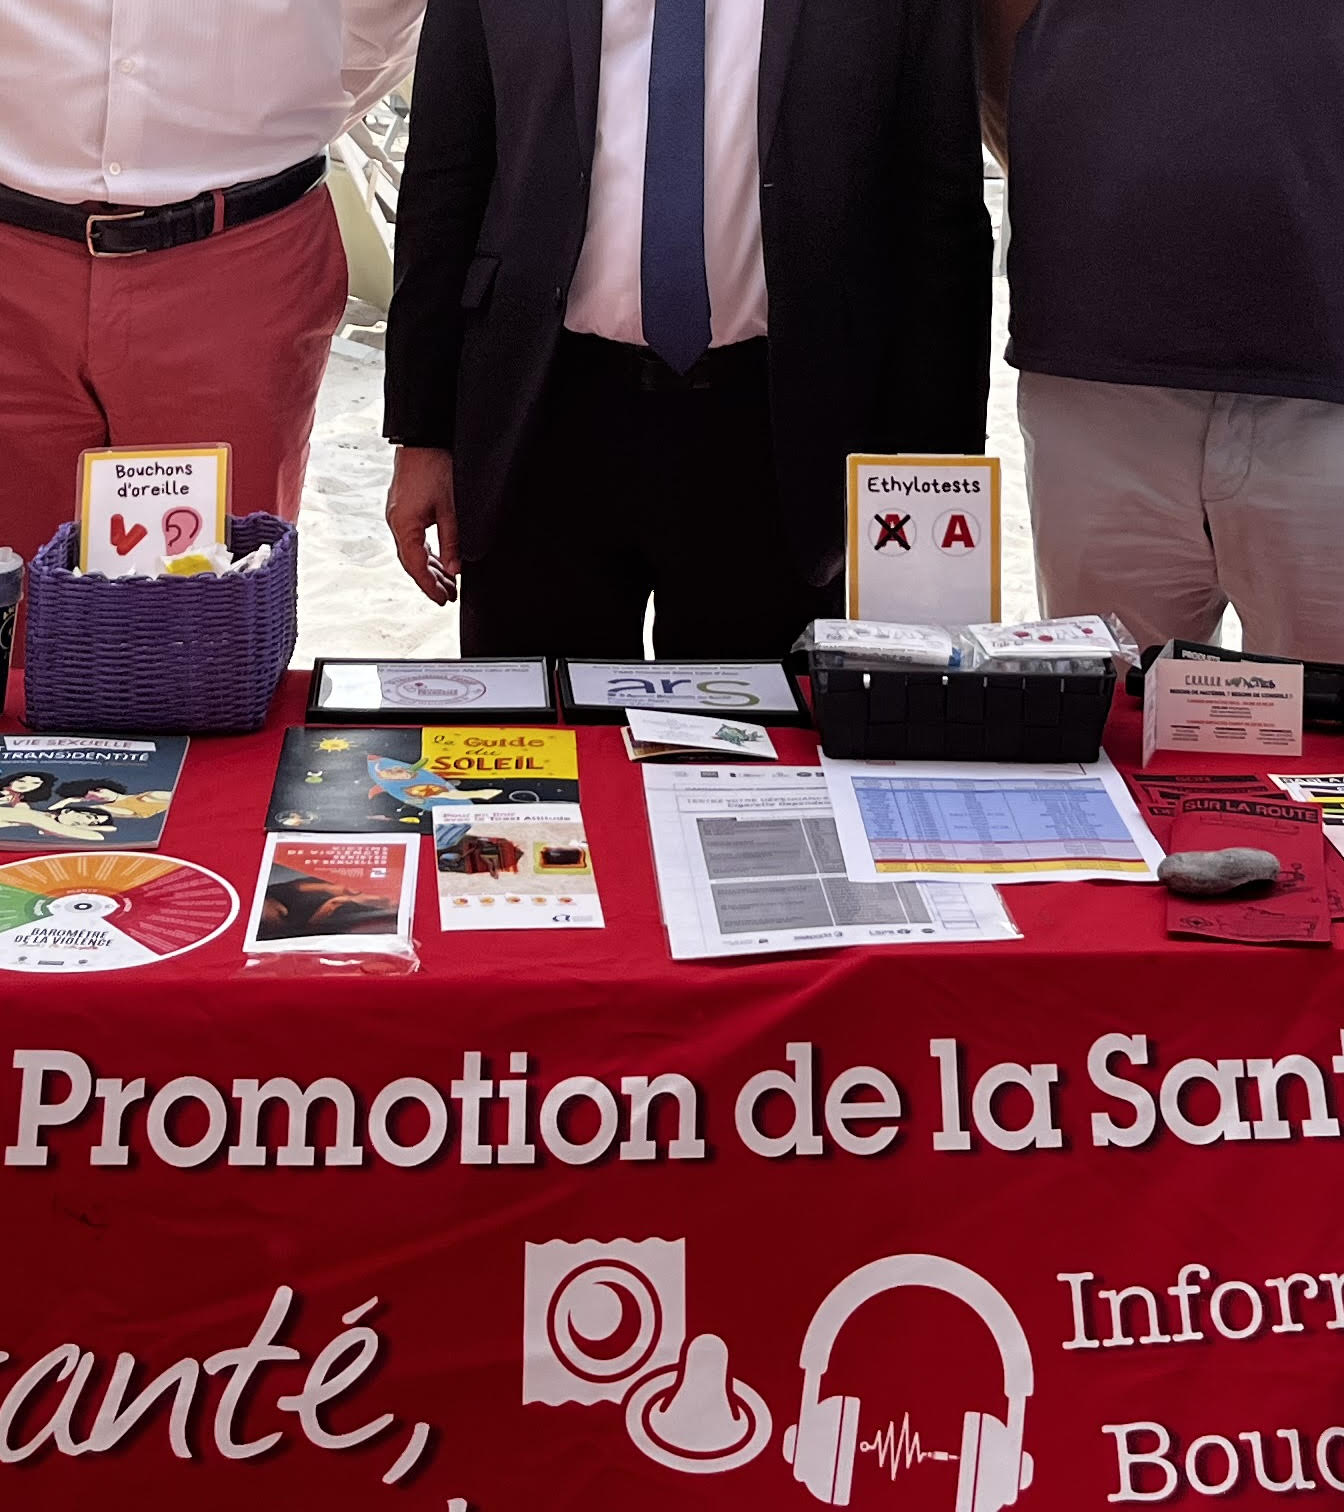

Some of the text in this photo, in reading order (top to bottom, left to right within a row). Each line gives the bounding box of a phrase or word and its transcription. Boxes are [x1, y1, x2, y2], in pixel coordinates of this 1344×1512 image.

[115, 462, 193, 479] Bouchons
[118, 480, 190, 498] d'oreille
[867, 476, 981, 496] Ethylotests
[941, 514, 976, 548] A
[608, 678, 760, 707] ars
[45, 739, 132, 749] SEXUELLE
[463, 736, 544, 748] Guide
[465, 748, 499, 756] du
[431, 755, 544, 771] SOLEIL
[1184, 800, 1221, 811] SUR
[1225, 801, 1250, 812] LA
[1256, 804, 1317, 821] ROUTE
[15, 935, 113, 947] DE LA VIOLENCE
[5, 1049, 706, 1170] Promotion
[734, 1040, 903, 1160] de
[927, 1037, 1063, 1152] la
